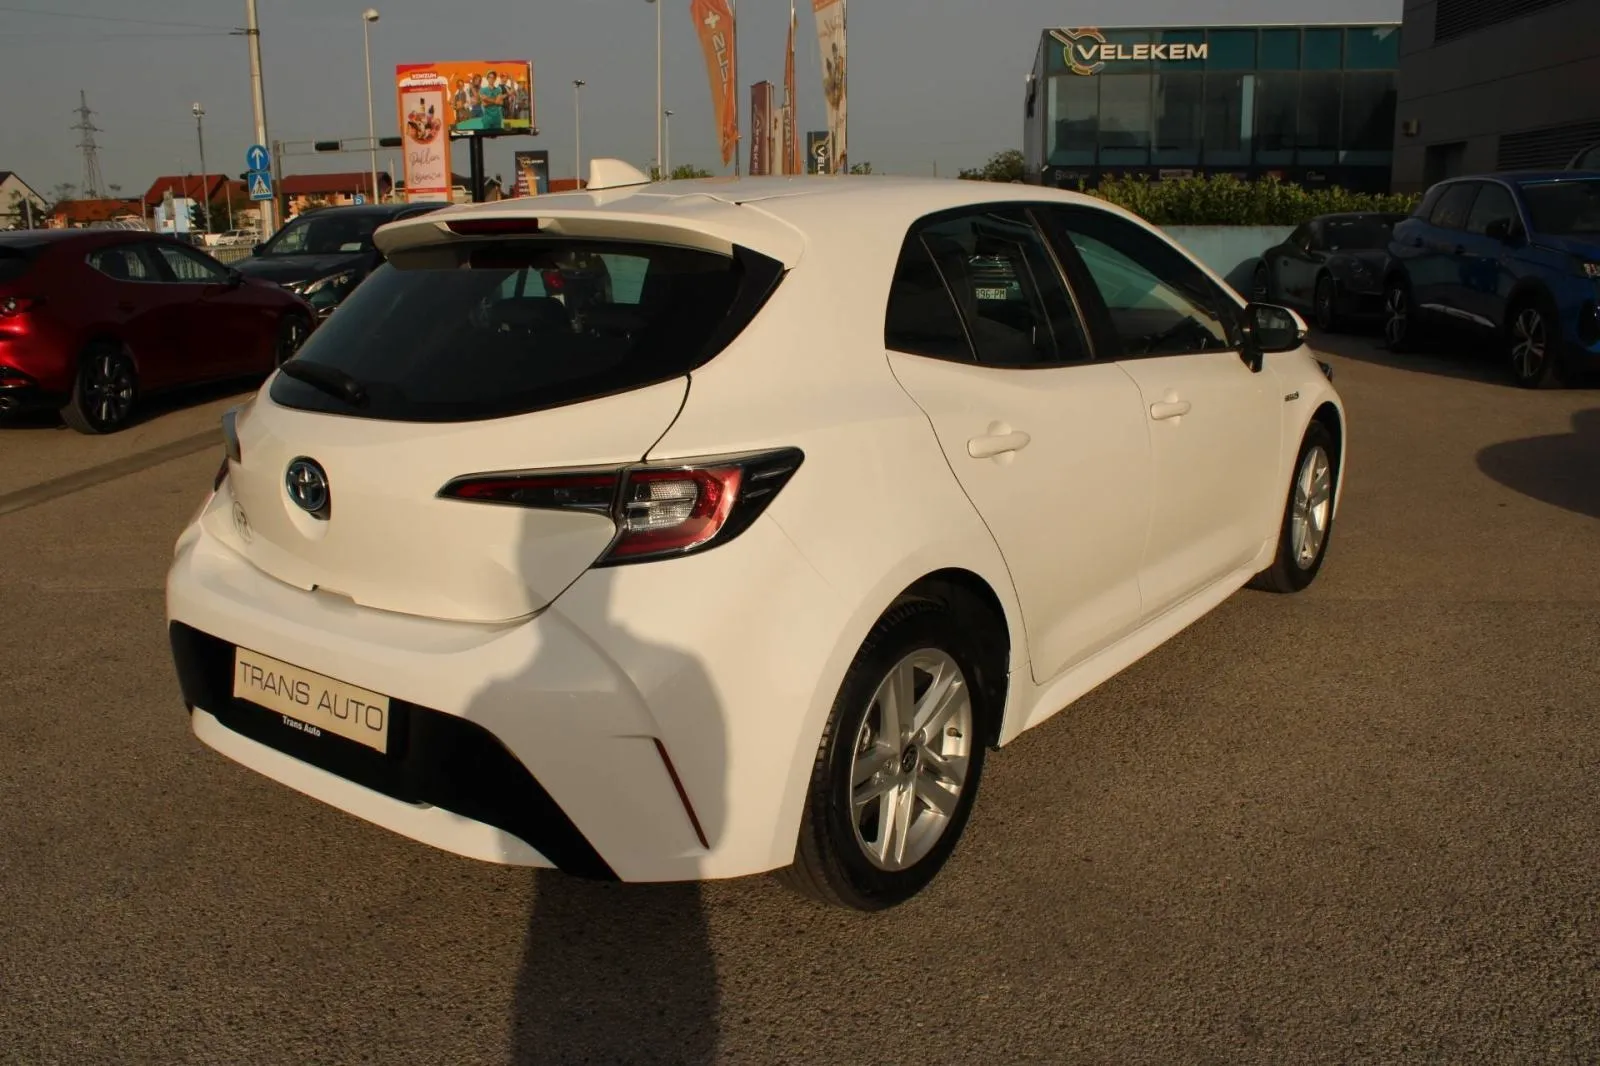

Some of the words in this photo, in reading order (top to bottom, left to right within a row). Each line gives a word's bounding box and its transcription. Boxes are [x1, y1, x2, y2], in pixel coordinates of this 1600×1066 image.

[1077, 44, 1208, 60] VELEKEM
[239, 660, 311, 706] TRANS
[317, 690, 384, 732] AUTO
[282, 715, 303, 731] Trans
[304, 723, 321, 738] Auto
